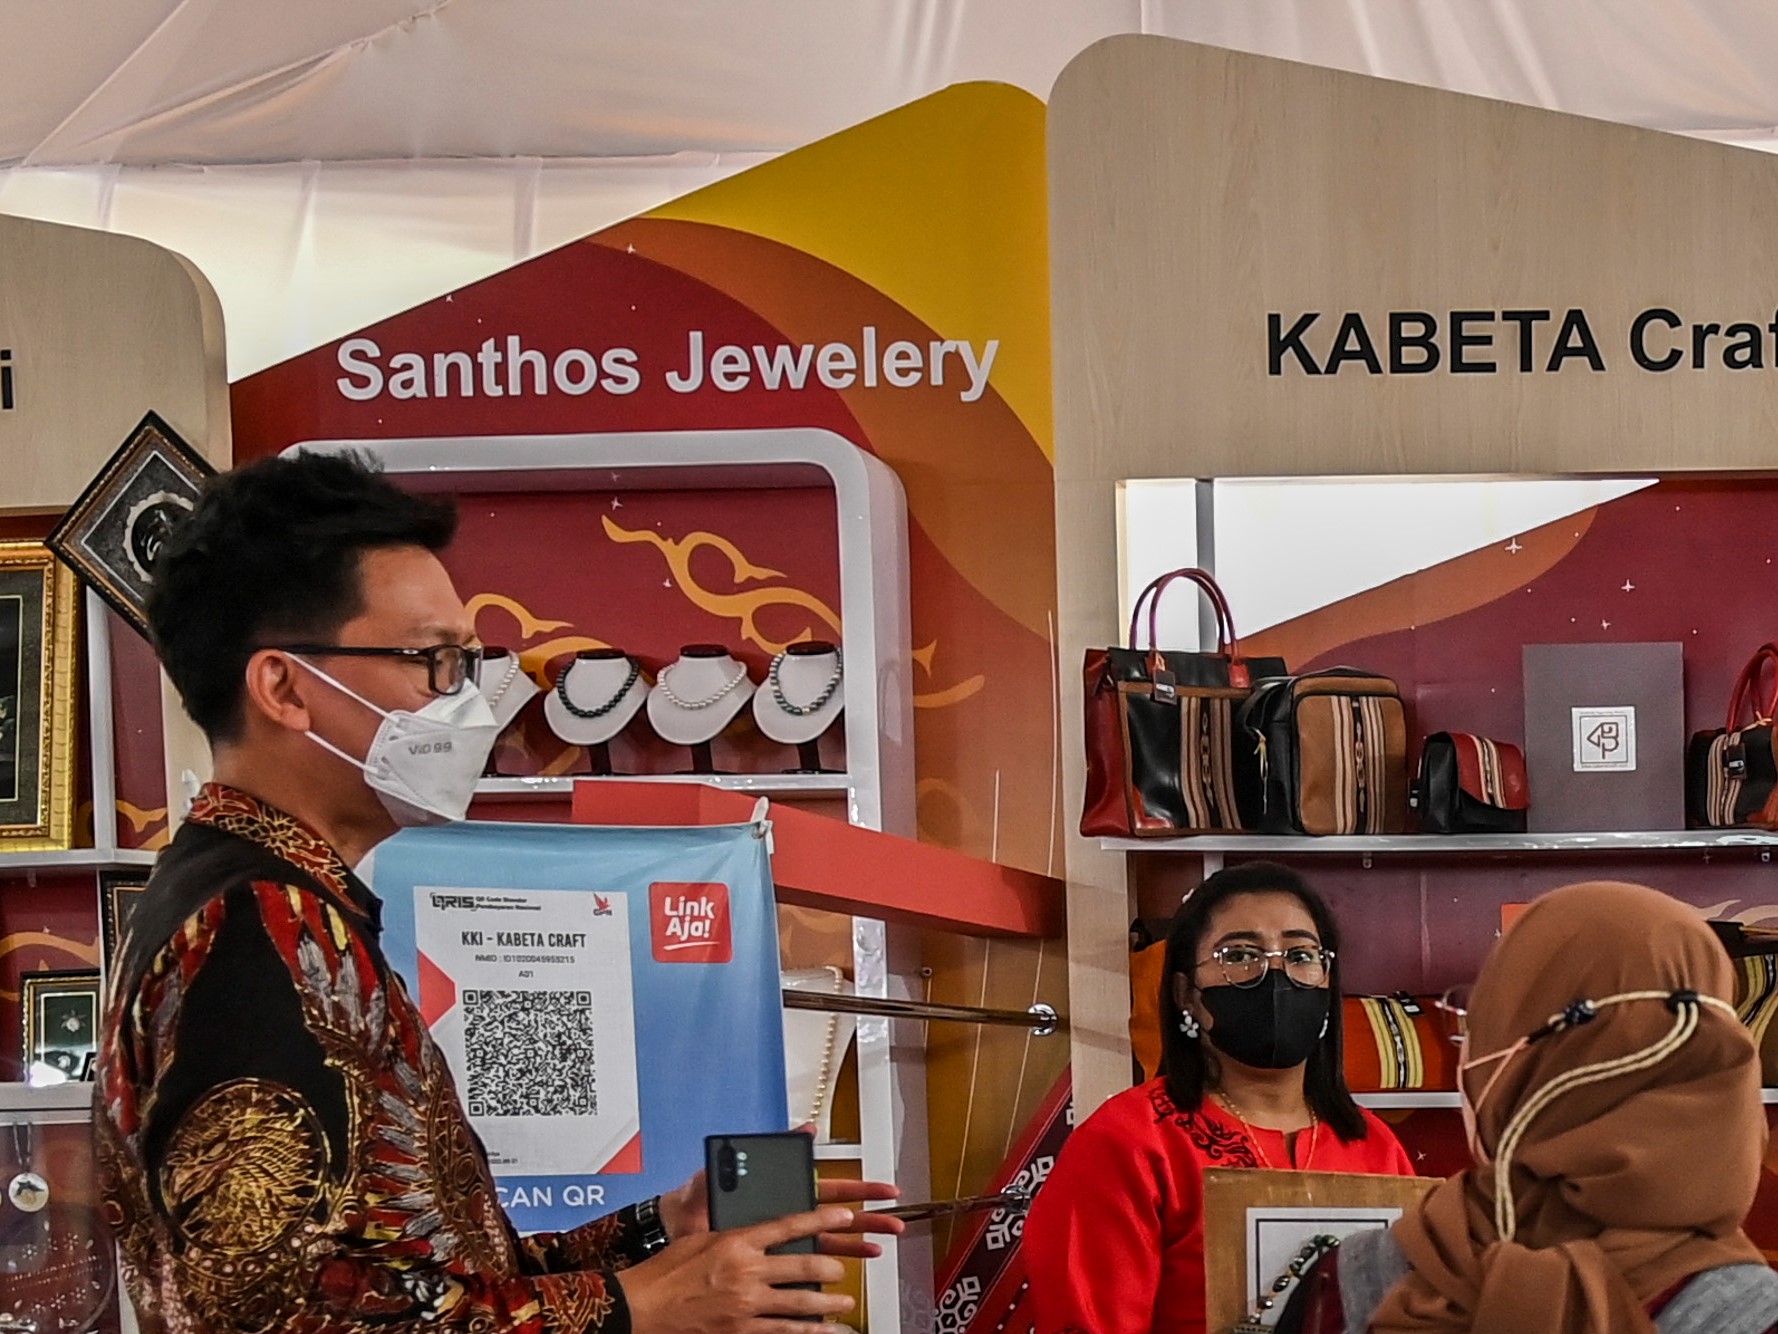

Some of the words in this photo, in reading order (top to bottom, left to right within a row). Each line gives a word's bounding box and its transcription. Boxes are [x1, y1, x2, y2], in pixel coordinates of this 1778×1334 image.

[1266, 308, 1607, 376] KABETA
[335, 334, 642, 400] Santhos
[664, 325, 1000, 402] Jewelery
[664, 895, 715, 919] Link
[461, 931, 483, 946] KKI
[497, 932, 545, 948] KABETA
[548, 933, 587, 948] CRAFT
[665, 916, 711, 942] Aja!
[562, 1184, 606, 1207] QR
